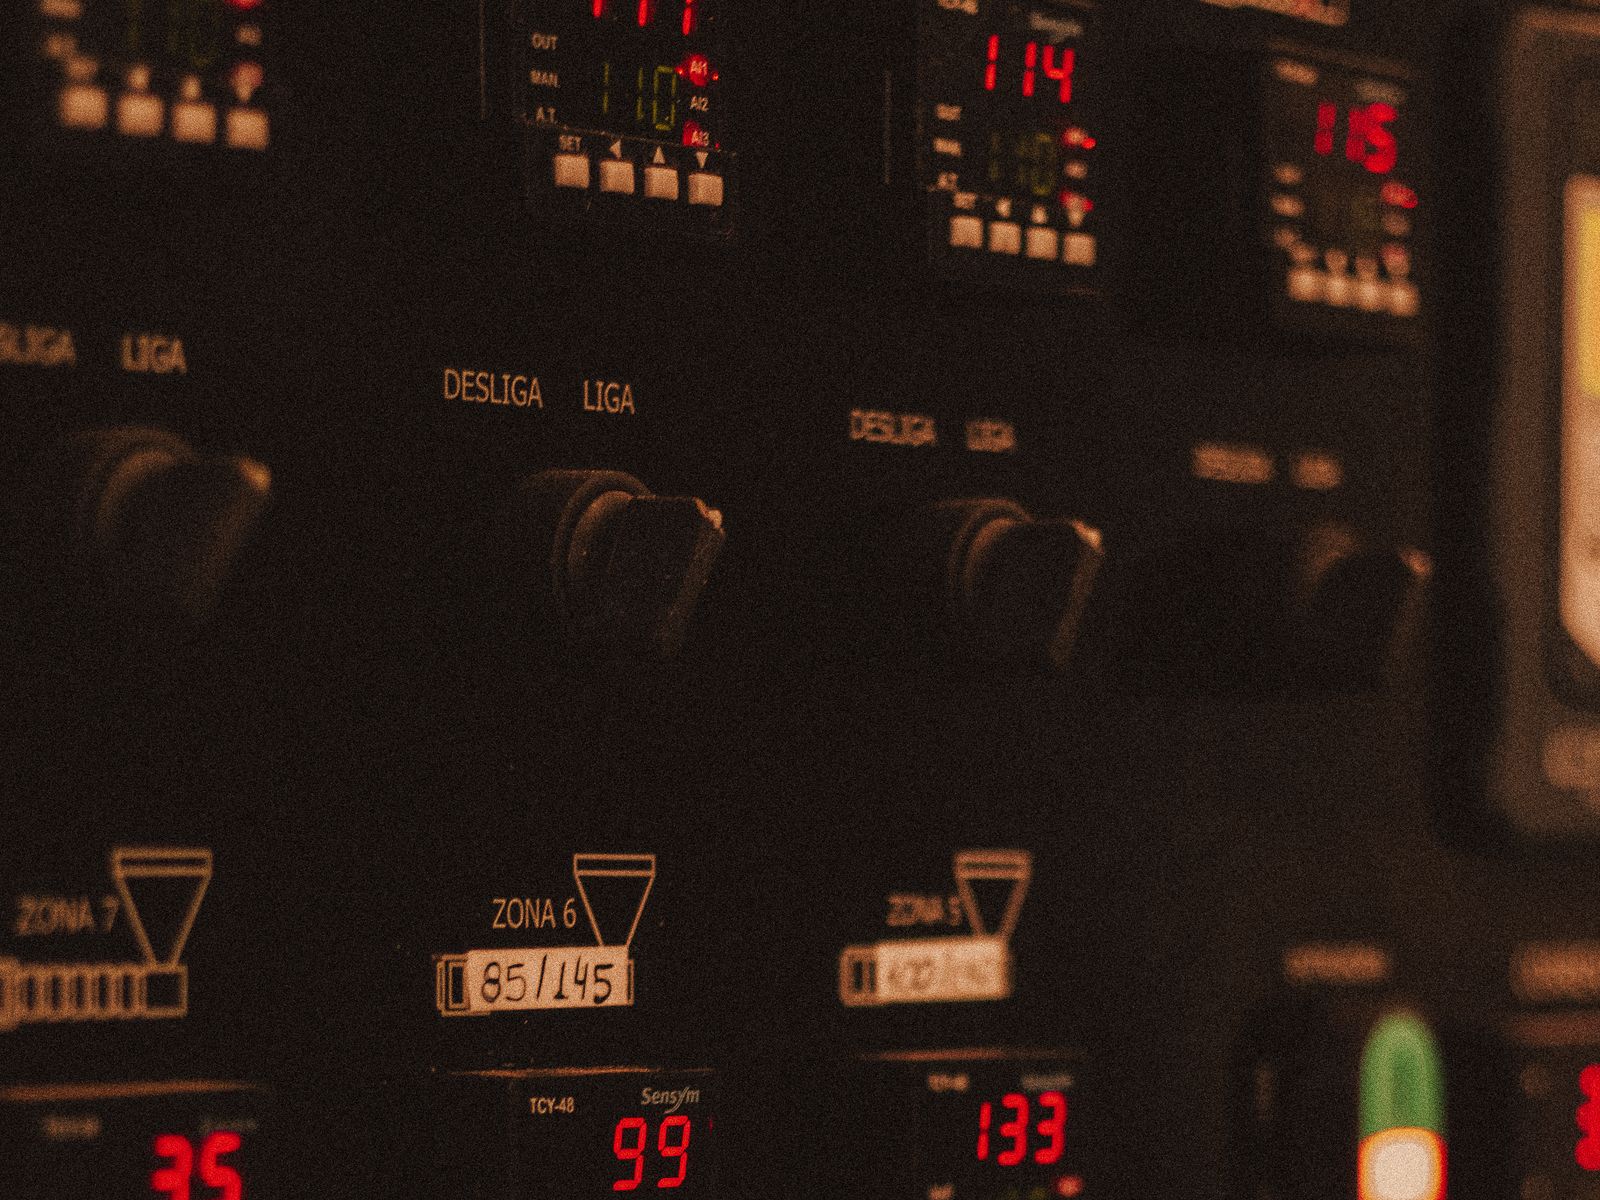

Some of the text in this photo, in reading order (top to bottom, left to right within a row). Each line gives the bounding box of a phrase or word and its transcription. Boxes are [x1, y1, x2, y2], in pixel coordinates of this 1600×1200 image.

[532, 32, 558, 50] OUT
[984, 33, 1076, 104] 114
[120, 331, 188, 376] LIGA
[443, 367, 636, 415] DESLIGA LIGA
[16, 894, 120, 937] ZONA 7
[491, 896, 578, 930] ZONA 6
[481, 953, 614, 1005] 85/145
[529, 1096, 576, 1115] TCY-48
[977, 1090, 1068, 1166] 133
[612, 1114, 691, 1192] 99
